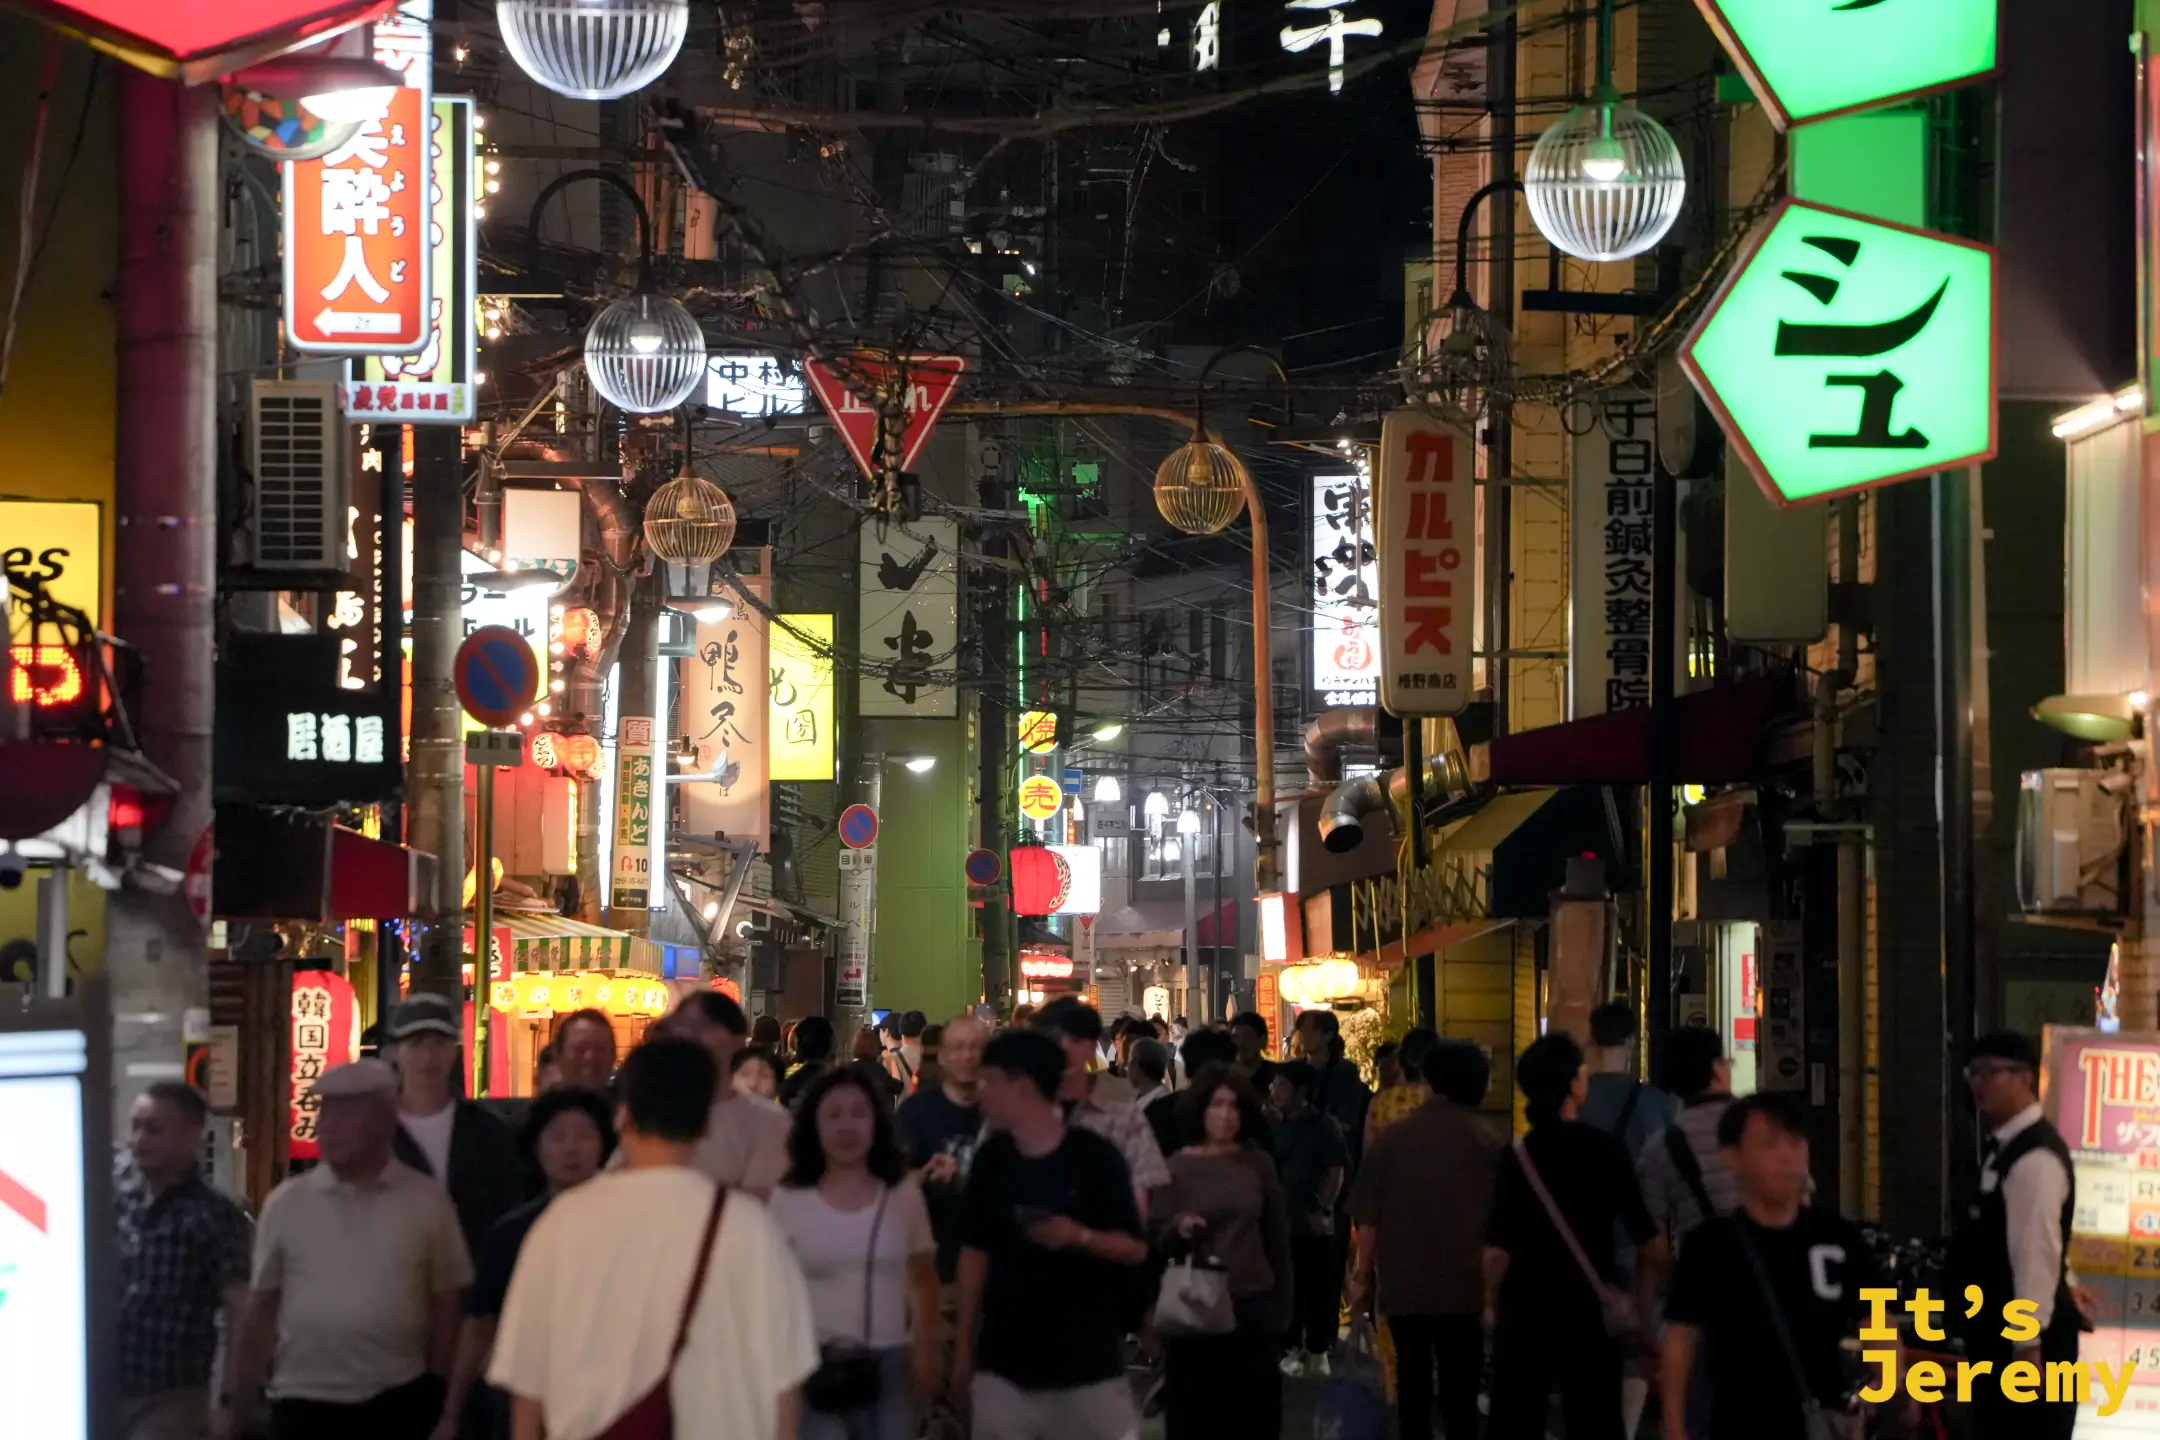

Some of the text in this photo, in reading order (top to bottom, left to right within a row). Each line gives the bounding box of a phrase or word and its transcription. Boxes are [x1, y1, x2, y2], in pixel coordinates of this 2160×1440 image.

[839, 383, 933, 413] 止れ
[1404, 430, 1461, 656] カルピス
[1604, 399, 1657, 711] 千日前鍼灸整骨院
[287, 712, 383, 763] 居酒屋
[625, 720, 651, 746] 質
[630, 757, 650, 843] あきんど
[841, 854, 873, 865] 自動車
[1808, 1244, 1847, 1299] C
